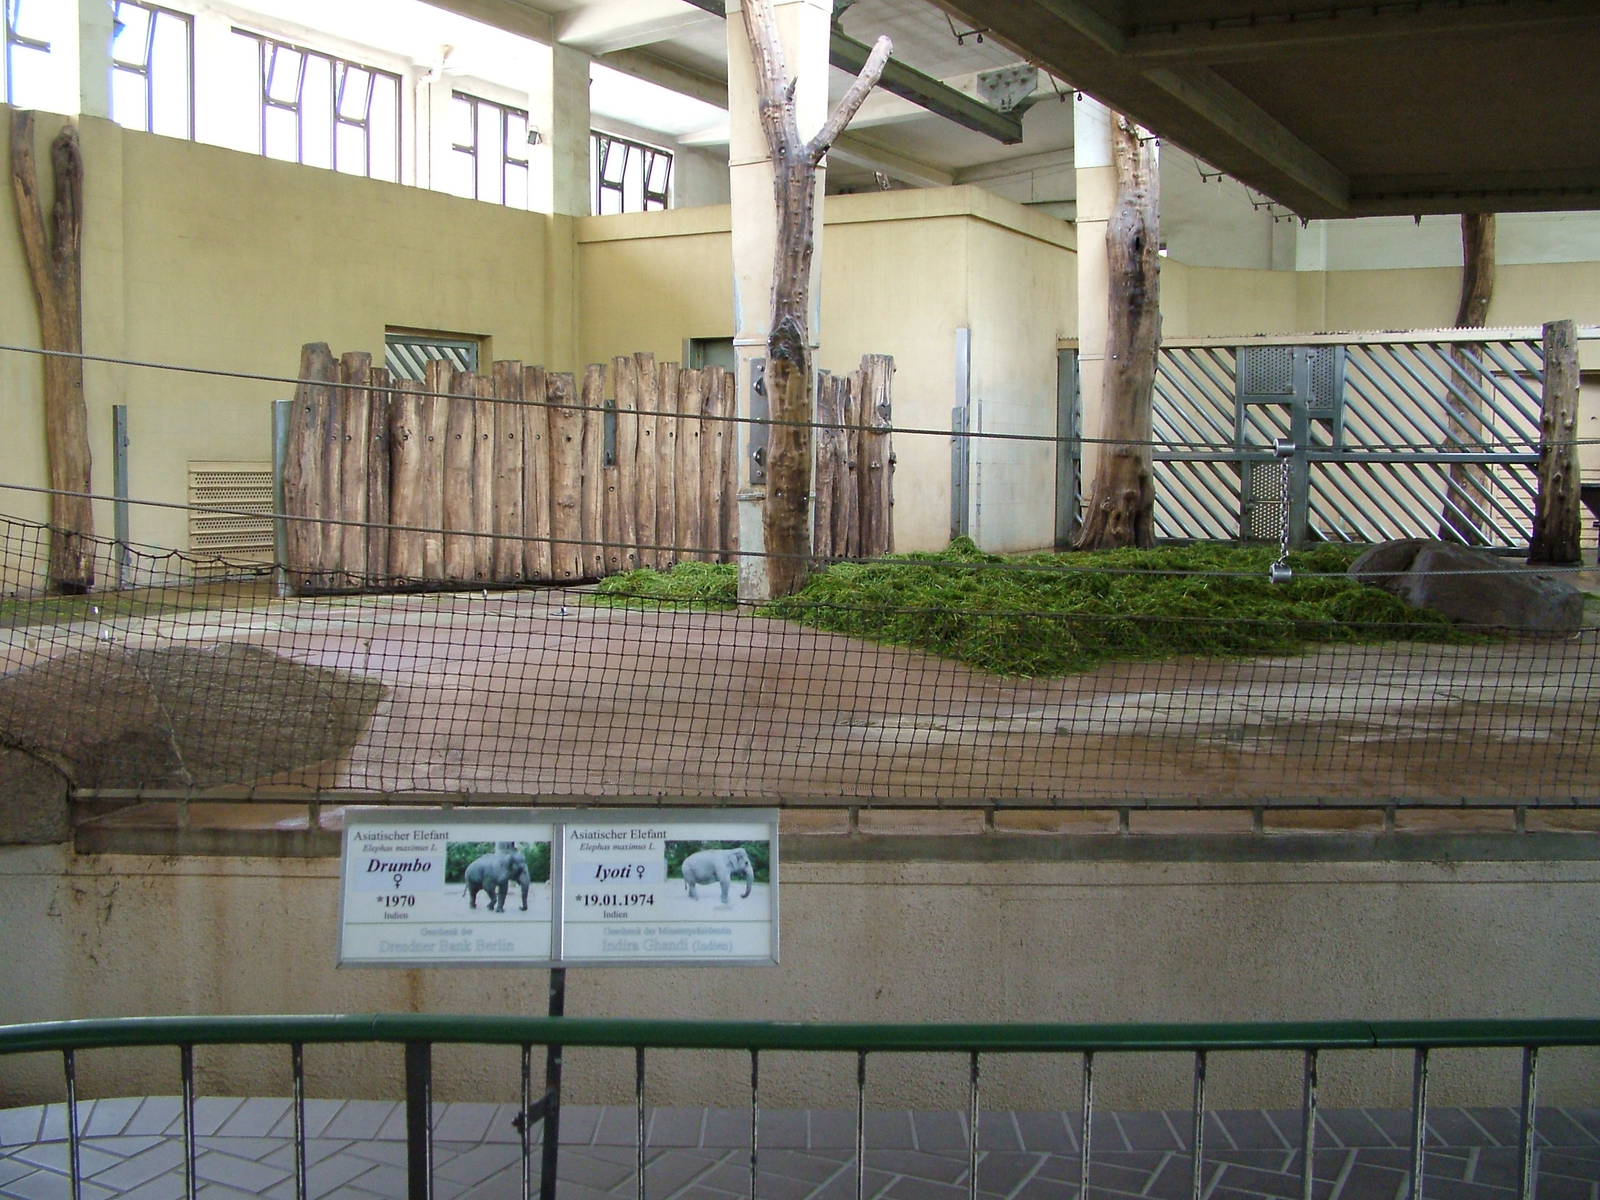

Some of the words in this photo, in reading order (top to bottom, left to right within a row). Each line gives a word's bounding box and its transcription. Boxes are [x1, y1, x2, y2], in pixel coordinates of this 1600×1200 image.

[354, 831, 409, 841] Asiatischer
[413, 830, 449, 840] Elefant
[570, 830, 627, 839] Asiatischer
[630, 829, 666, 839] Elefant
[580, 843, 610, 853] Elephas
[367, 858, 432, 873] Drumbo
[384, 911, 409, 919] Indien
[603, 910, 628, 918] Indien
